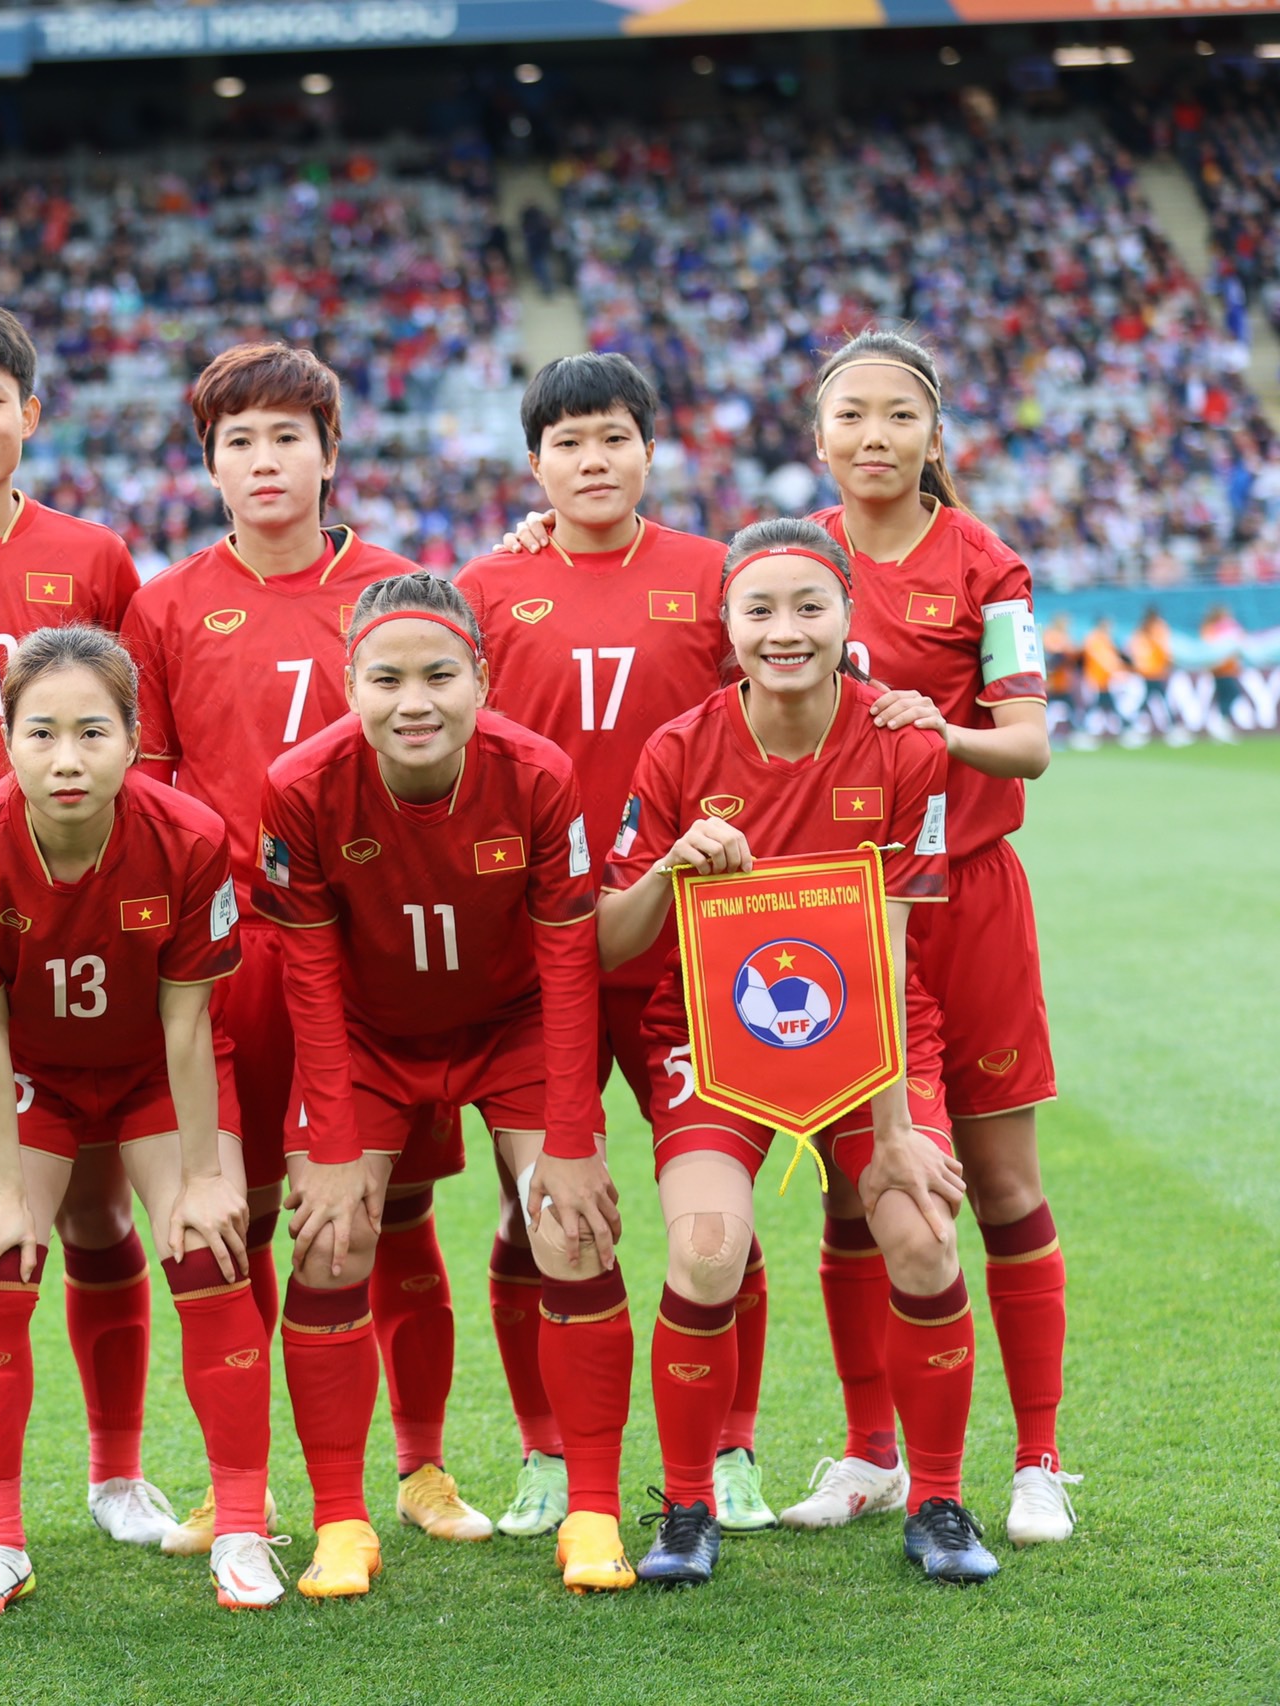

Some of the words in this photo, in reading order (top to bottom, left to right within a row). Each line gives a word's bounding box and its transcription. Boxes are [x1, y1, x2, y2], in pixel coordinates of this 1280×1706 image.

[276, 658, 313, 743] 7
[572, 647, 636, 731] 17
[700, 896, 744, 918] VIETNAM
[745, 890, 797, 914] FOOTBALL
[798, 885, 861, 909] FEDERATION
[403, 904, 459, 972] 11
[45, 954, 108, 1018] 13
[777, 1018, 810, 1034] VFF
[663, 1043, 695, 1110] 5
